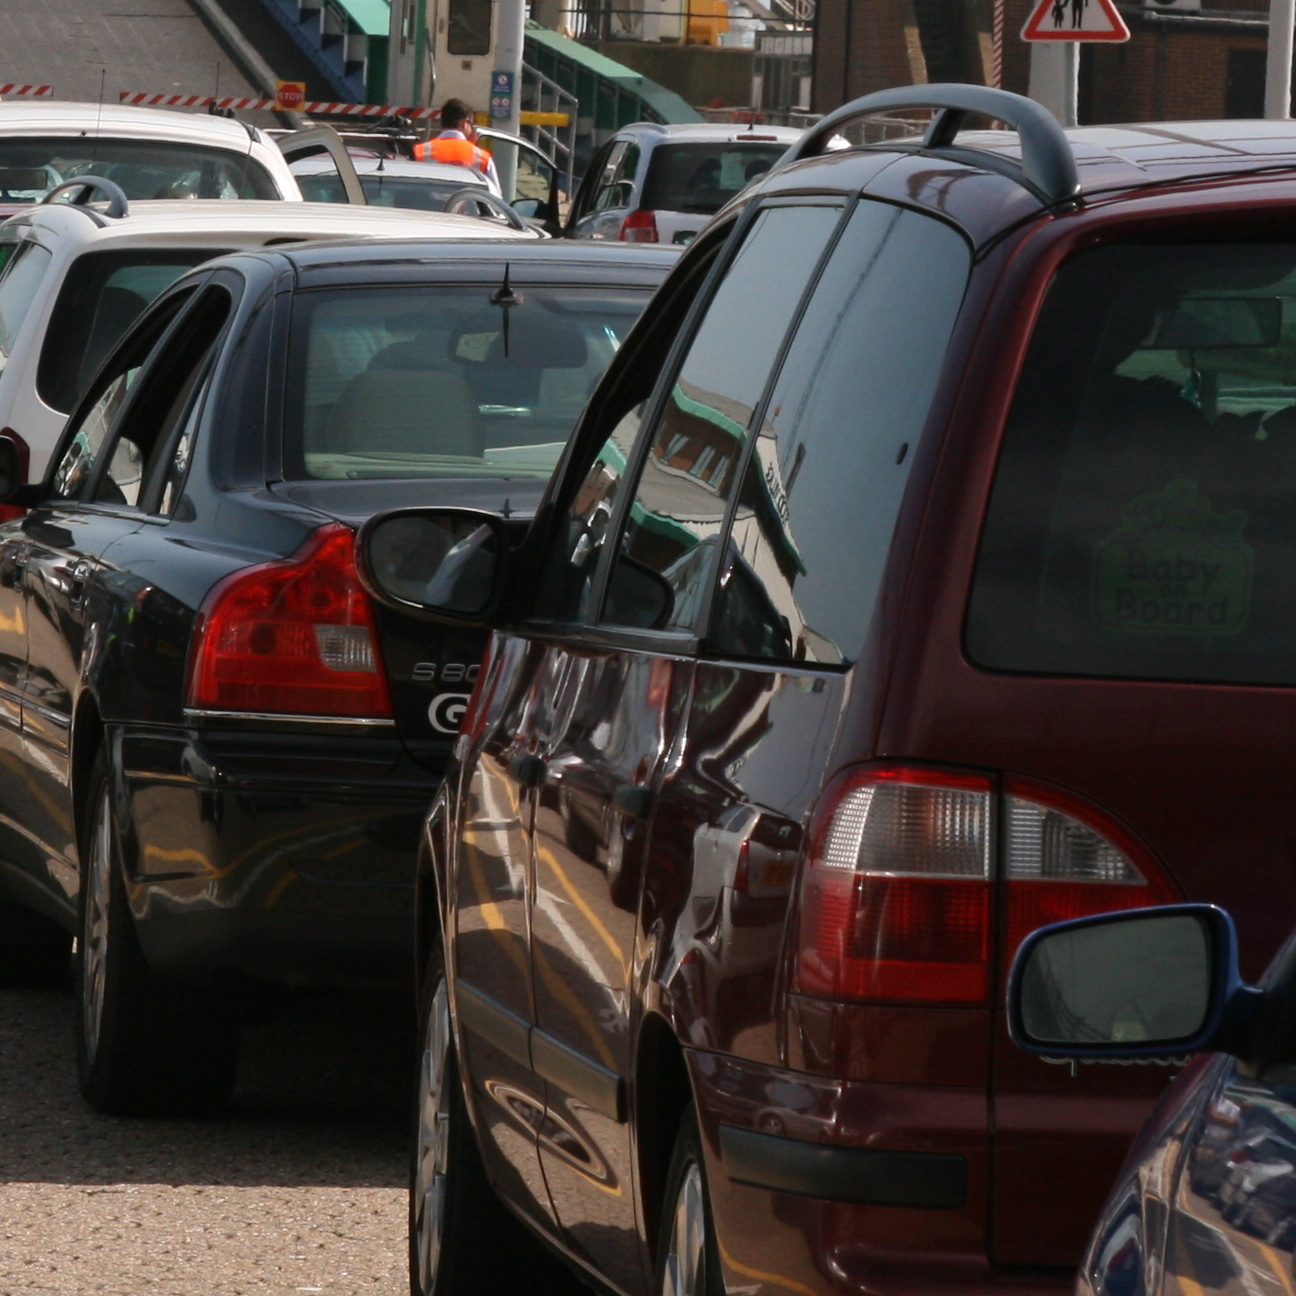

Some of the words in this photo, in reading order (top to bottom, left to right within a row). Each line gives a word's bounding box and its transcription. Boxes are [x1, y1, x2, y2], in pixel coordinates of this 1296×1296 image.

[278, 92, 303, 101] STOP
[1126, 544, 1222, 592] Baby
[1117, 587, 1229, 625] Board
